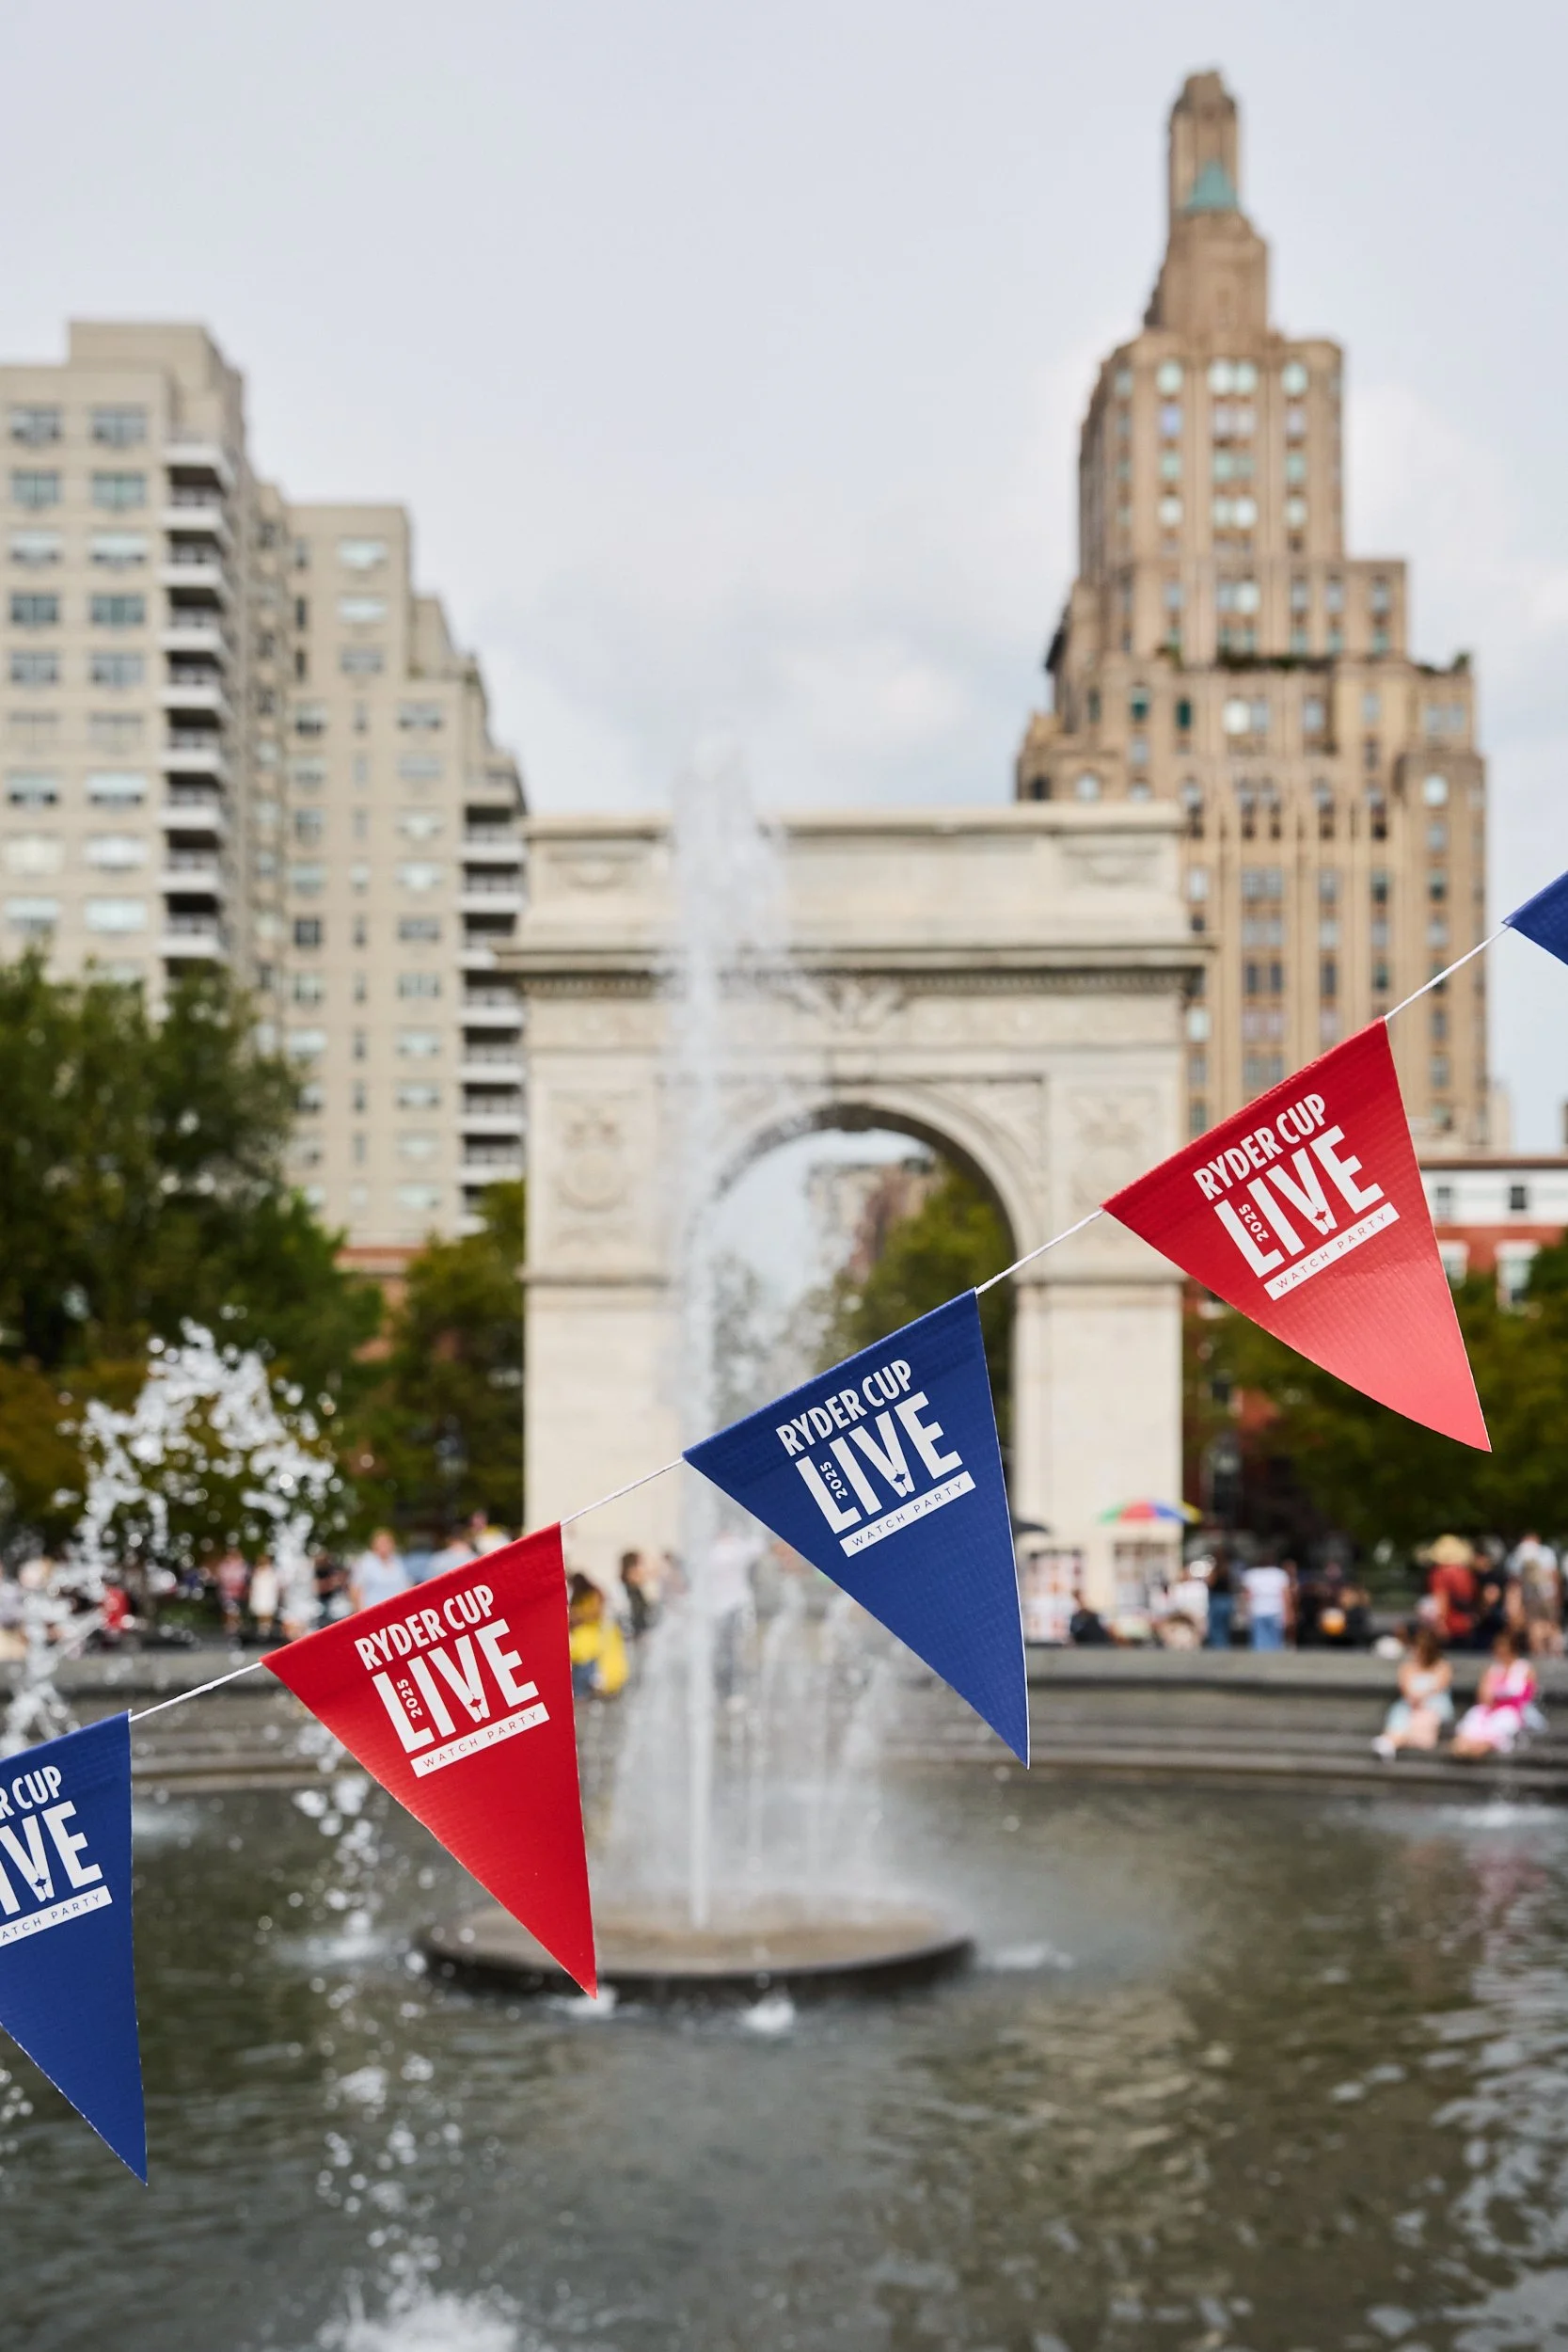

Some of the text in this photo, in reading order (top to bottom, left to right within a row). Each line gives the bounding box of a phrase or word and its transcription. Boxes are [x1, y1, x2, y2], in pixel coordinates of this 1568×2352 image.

[1193, 1094, 1325, 1200] RYDER CUP
[1213, 1125, 1385, 1279] LIVE
[1239, 1204, 1269, 1242] 2025
[1276, 1214, 1386, 1288] WATCH PARTY
[776, 1359, 911, 1456] RYDER CUP
[795, 1391, 963, 1534] LIVE
[820, 1461, 847, 1499] 2025
[852, 1482, 962, 1546] WATCH PARTY
[355, 1585, 493, 1670] RYDER CUP
[372, 1618, 539, 1754] LIVE
[397, 1679, 422, 1718] 2025
[423, 1712, 536, 1768] WATCH PARTY
[12, 1766, 61, 1809] CUP
[0, 1801, 103, 1915] VE
[3, 1895, 101, 1940] ATCH PARTY
